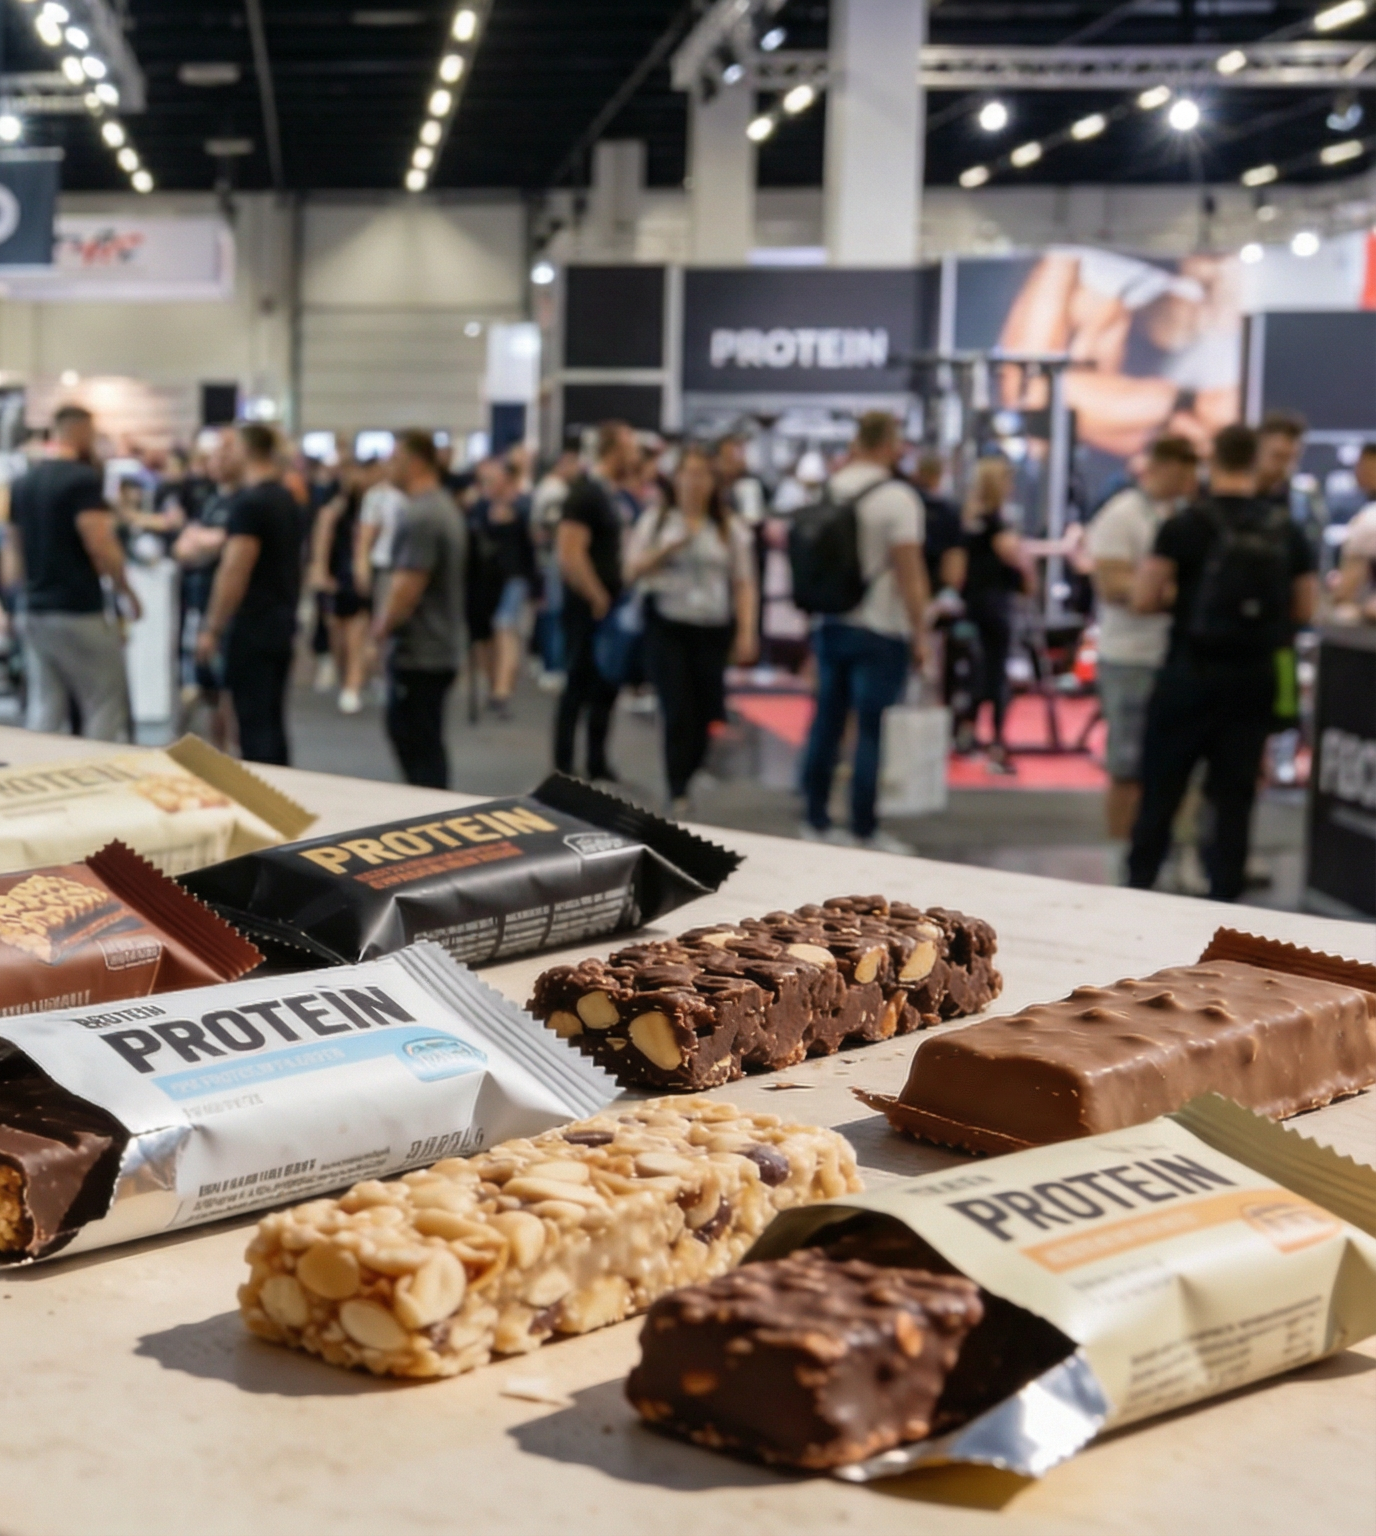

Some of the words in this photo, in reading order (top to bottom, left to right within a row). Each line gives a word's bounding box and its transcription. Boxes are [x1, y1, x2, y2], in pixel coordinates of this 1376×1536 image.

[709, 326, 890, 370] PROTEIN
[298, 806, 560, 875] PROTEIN
[98, 985, 417, 1075] PROTEIN
[947, 1154, 1239, 1242] PROTEIN
